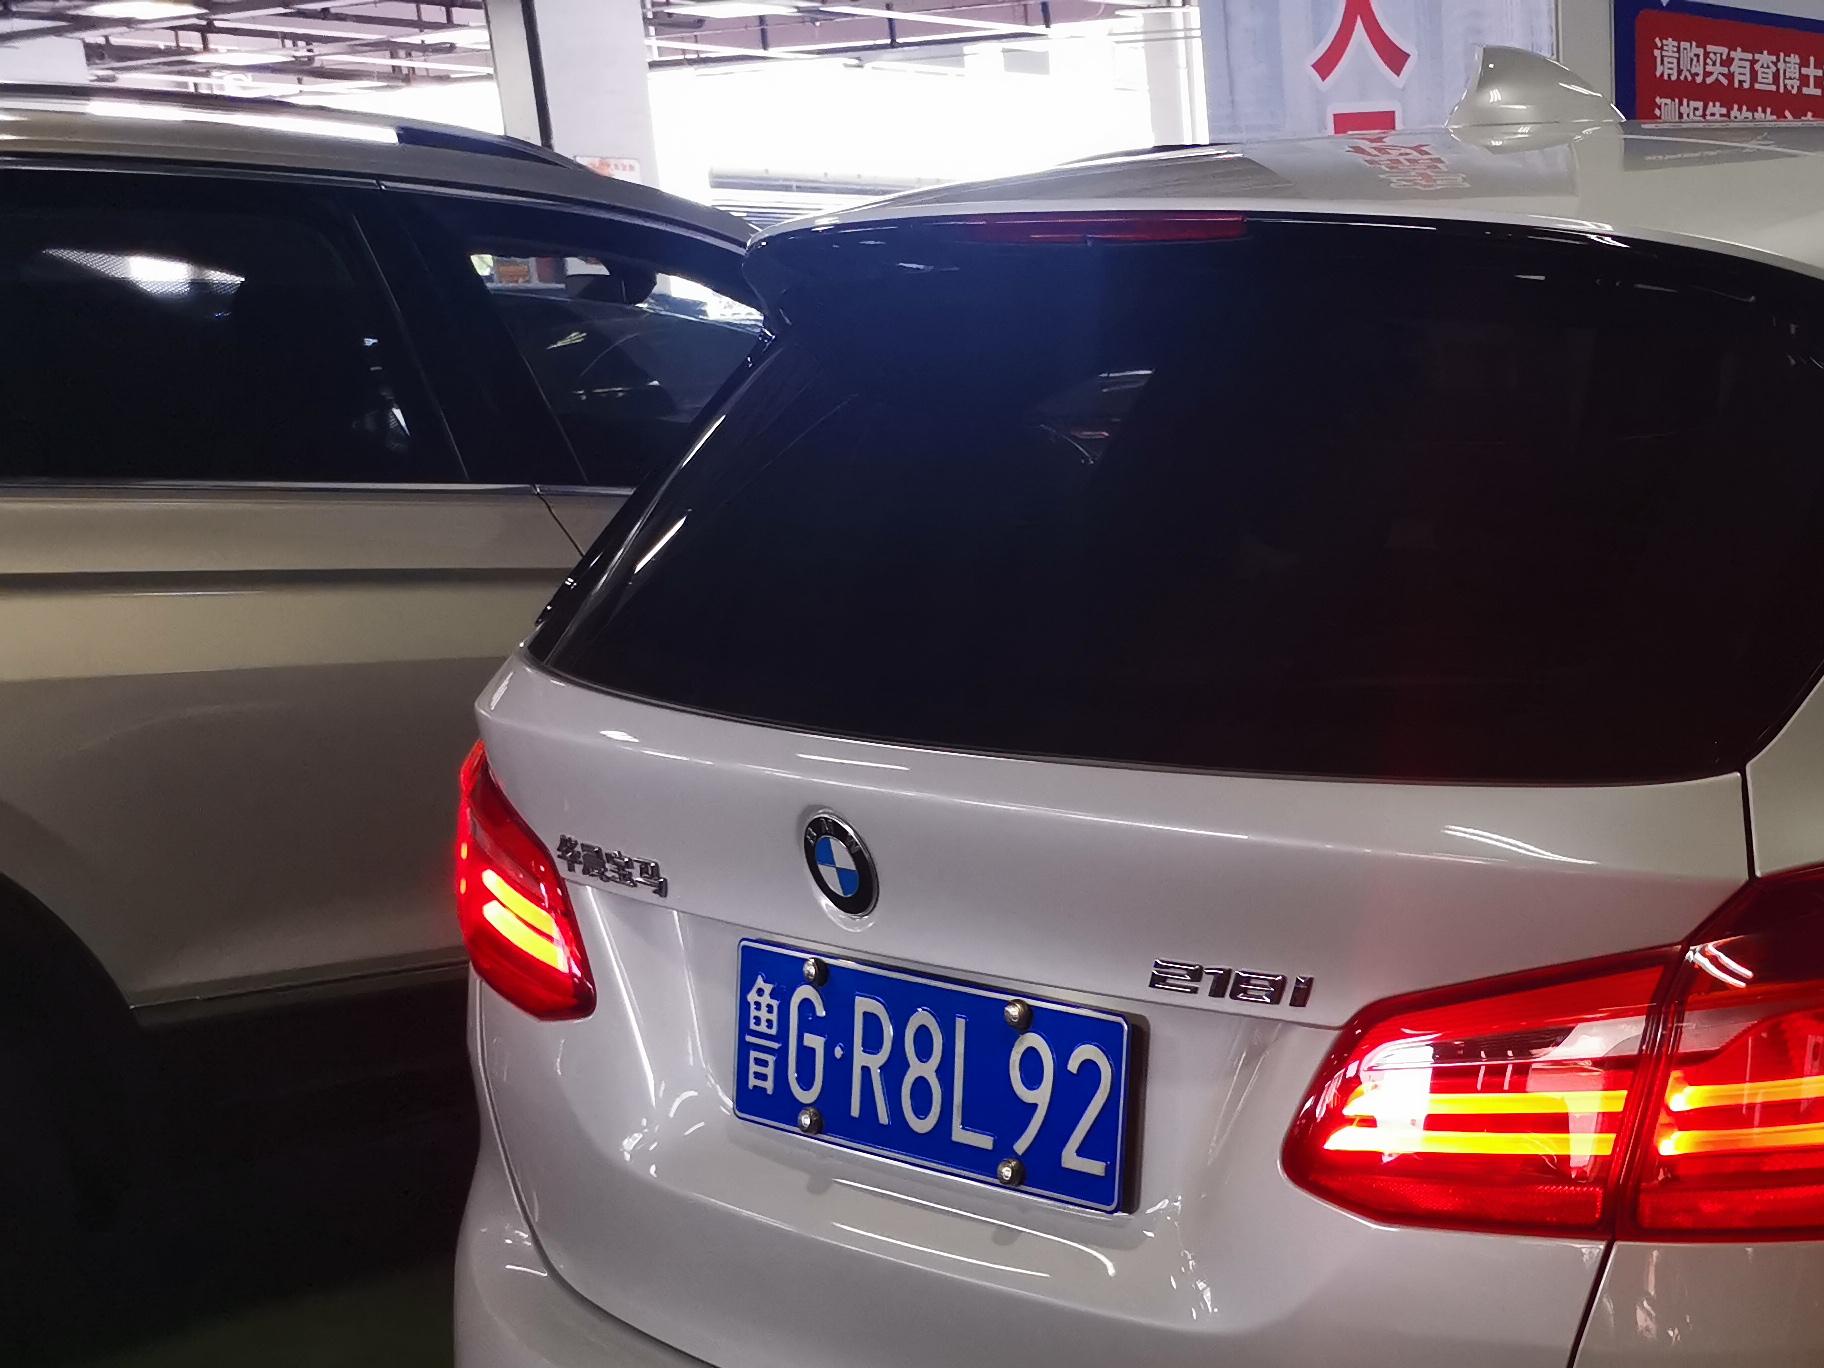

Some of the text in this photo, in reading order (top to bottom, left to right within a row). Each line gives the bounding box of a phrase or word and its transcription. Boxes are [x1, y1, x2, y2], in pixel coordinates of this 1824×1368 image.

[1310, 0, 1412, 135] 人
[557, 834, 668, 898] 华晨宝马
[1149, 958, 1315, 1008] 218i
